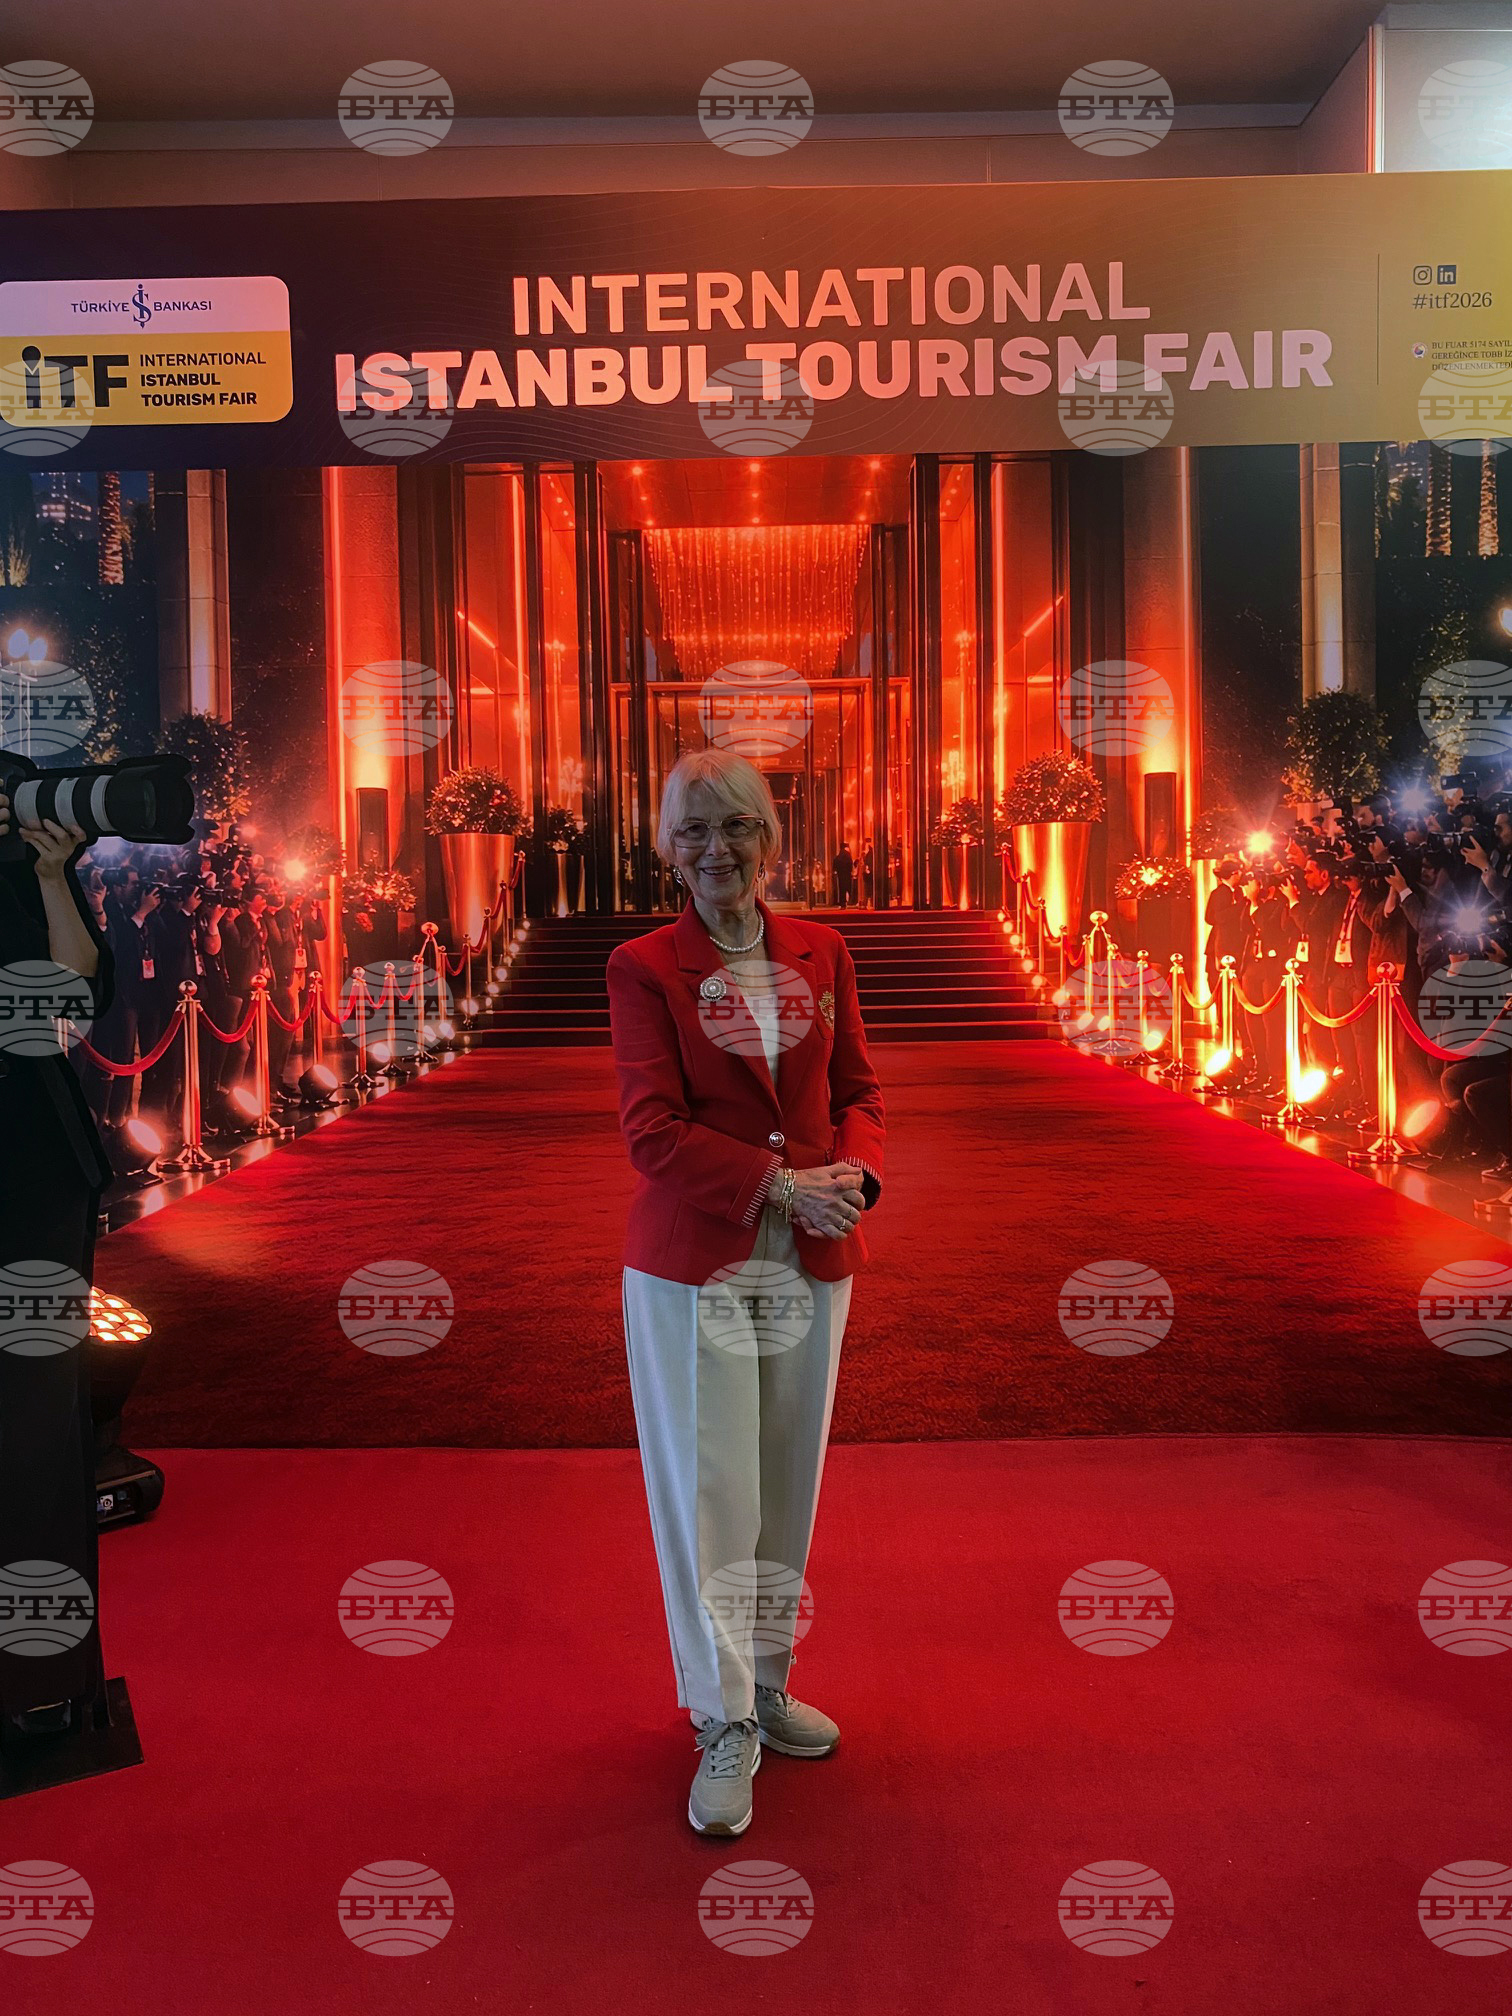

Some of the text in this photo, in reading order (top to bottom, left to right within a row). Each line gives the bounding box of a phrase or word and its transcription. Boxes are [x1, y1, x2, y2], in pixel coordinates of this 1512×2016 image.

[513, 261, 1151, 336] INTERNATIONAL
[1412, 292, 1493, 309] #itf2026
[71, 300, 130, 313] TÜRKİYE
[153, 300, 212, 312] BANKASI
[1432, 341, 1444, 350] BU
[1445, 341, 1468, 349] FUAR
[1470, 340, 1487, 348] 5174
[140, 352, 267, 367] INTERNATIONAL
[1431, 350, 1479, 360] GEREĞİNCE
[1481, 350, 1503, 359] TOBB
[335, 329, 1334, 412] ISTANBUL TOURISM FAIR
[141, 373, 221, 387] ISTANBUL
[141, 392, 257, 407] TOURISM FAIR
